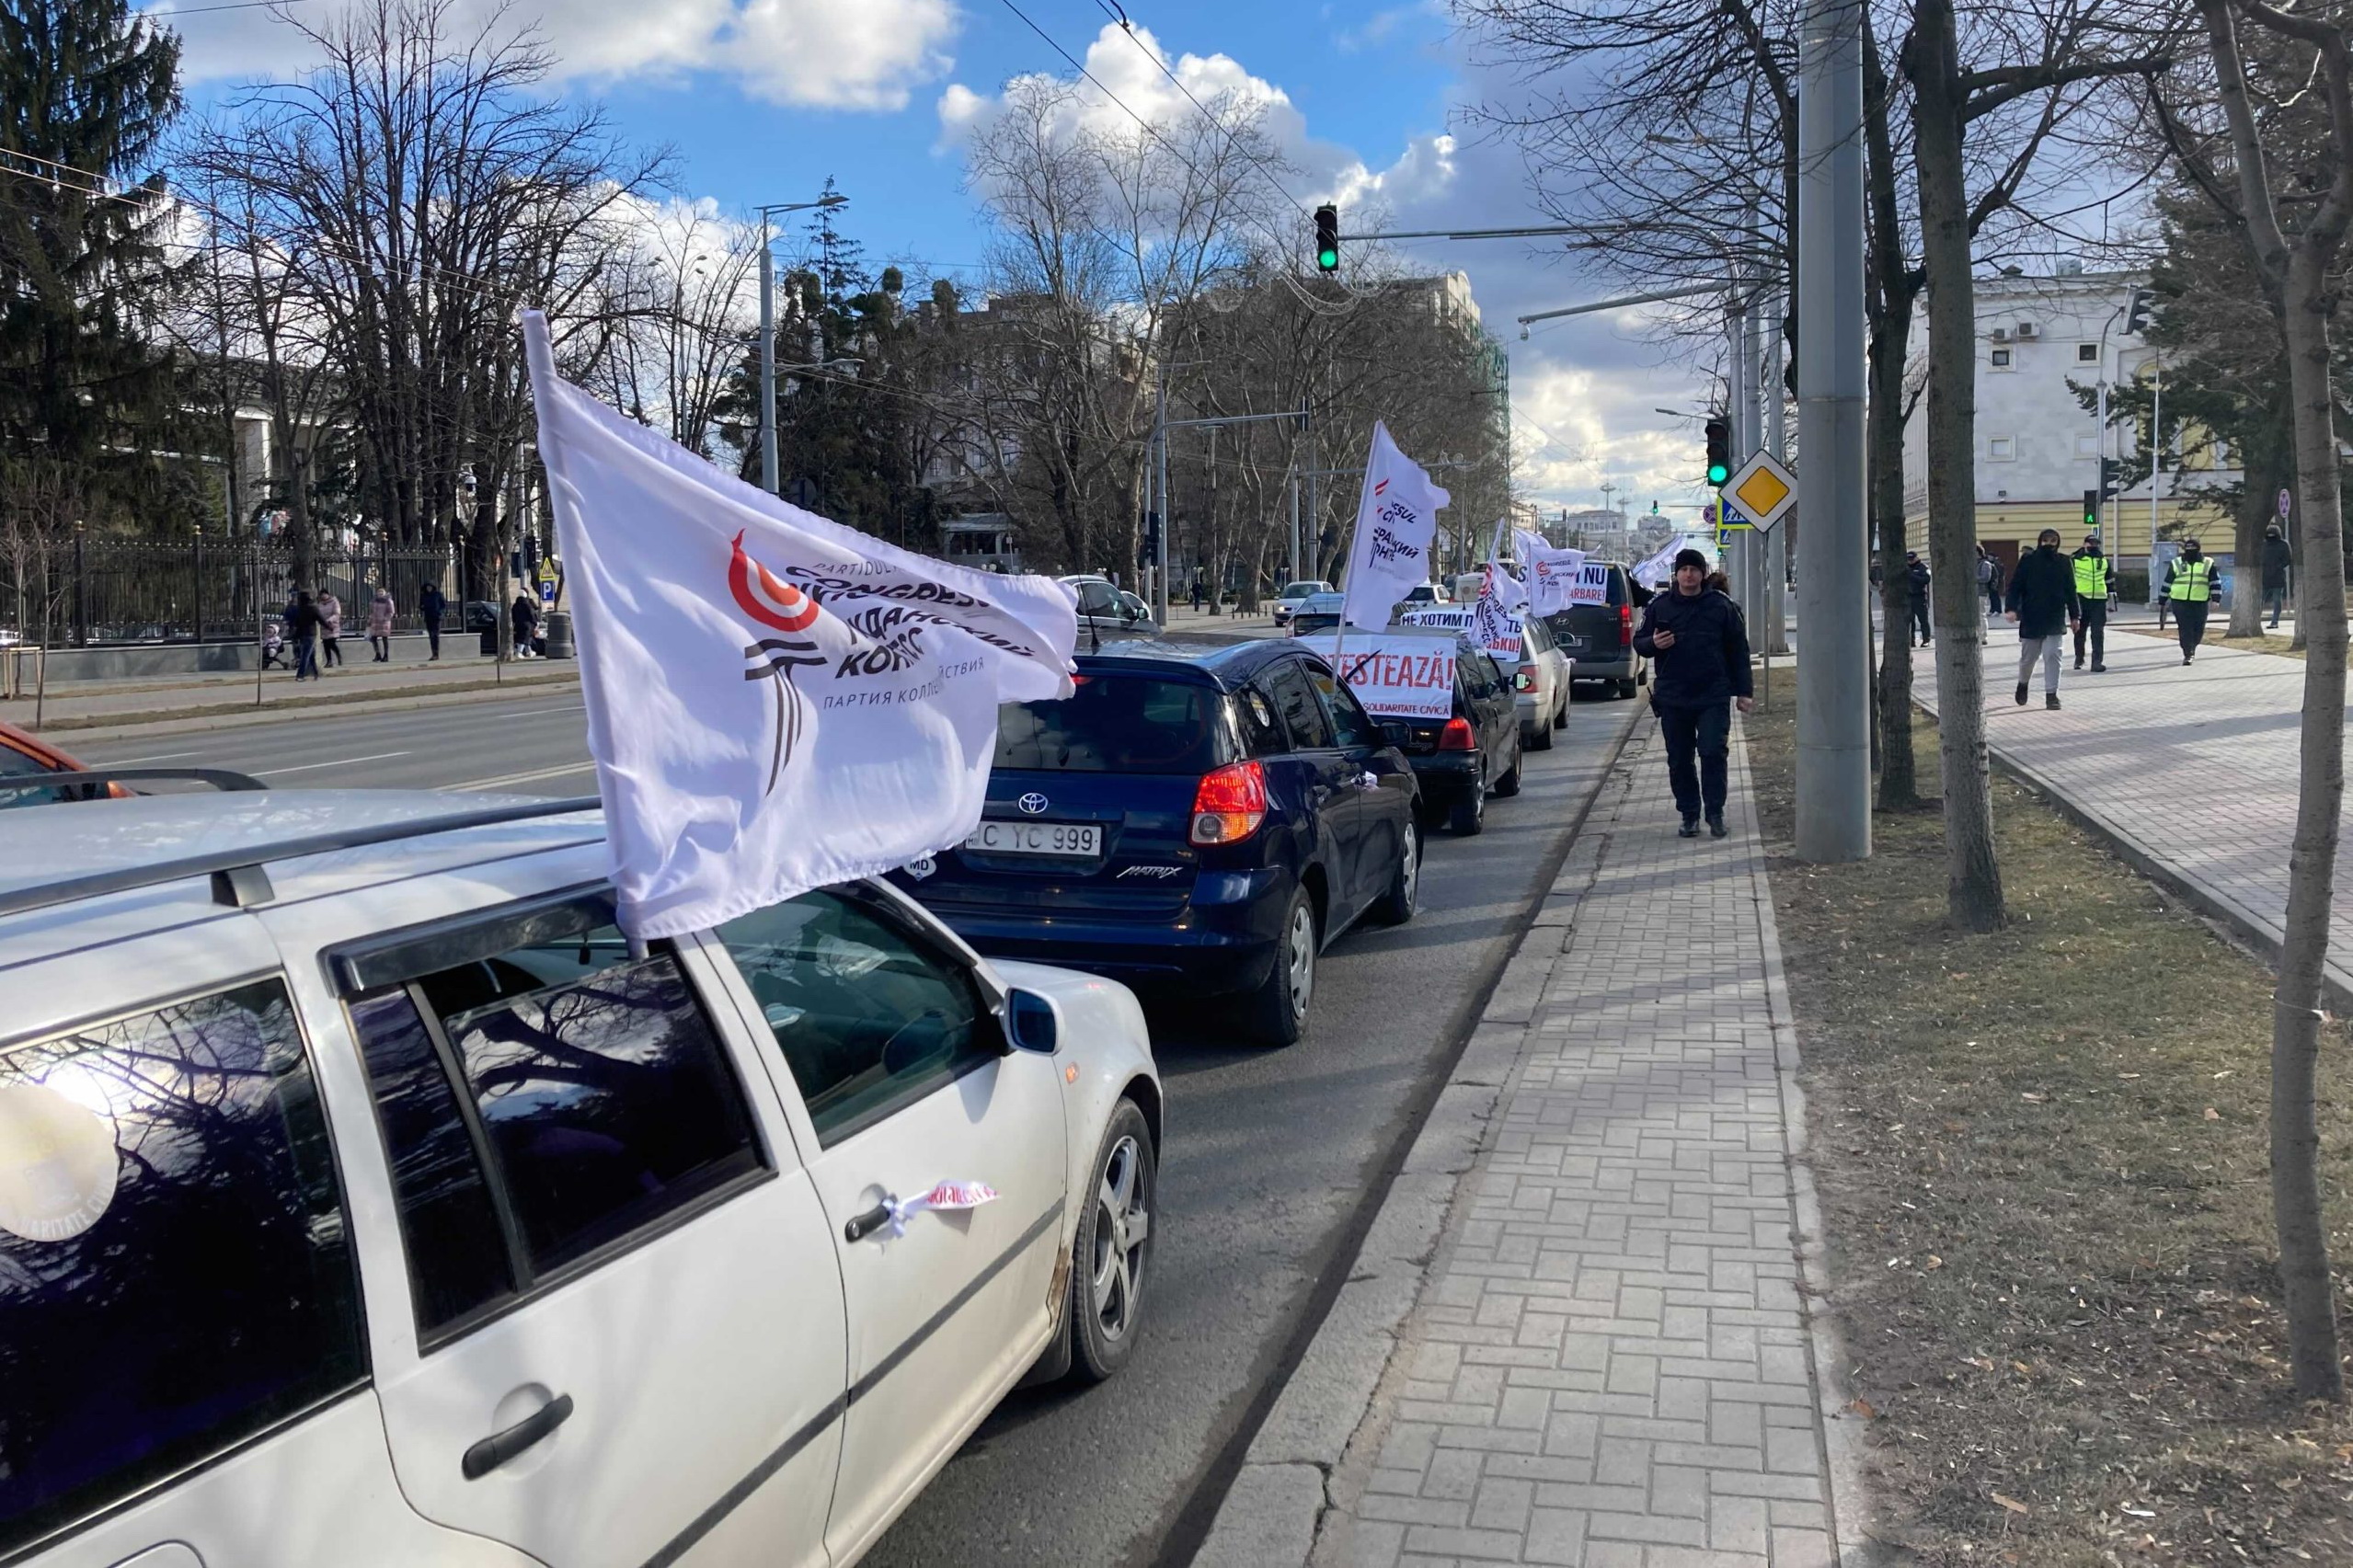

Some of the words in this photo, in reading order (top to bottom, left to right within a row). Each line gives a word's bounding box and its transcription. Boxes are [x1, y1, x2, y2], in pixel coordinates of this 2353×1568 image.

[1584, 567, 1606, 585] NU
[543, 582, 552, 600] P
[1402, 615, 1417, 624] НЕ
[1420, 614, 1463, 626] ХОТИМ
[823, 692, 891, 710] ПАРТИЯ
[1362, 702, 1418, 714] SOLIDARITATE
[1419, 704, 1449, 715] CIVICĂ
[1052, 827, 1093, 851] 999
[910, 859, 929, 871] MD
[1116, 865, 1184, 879] MATRIX
